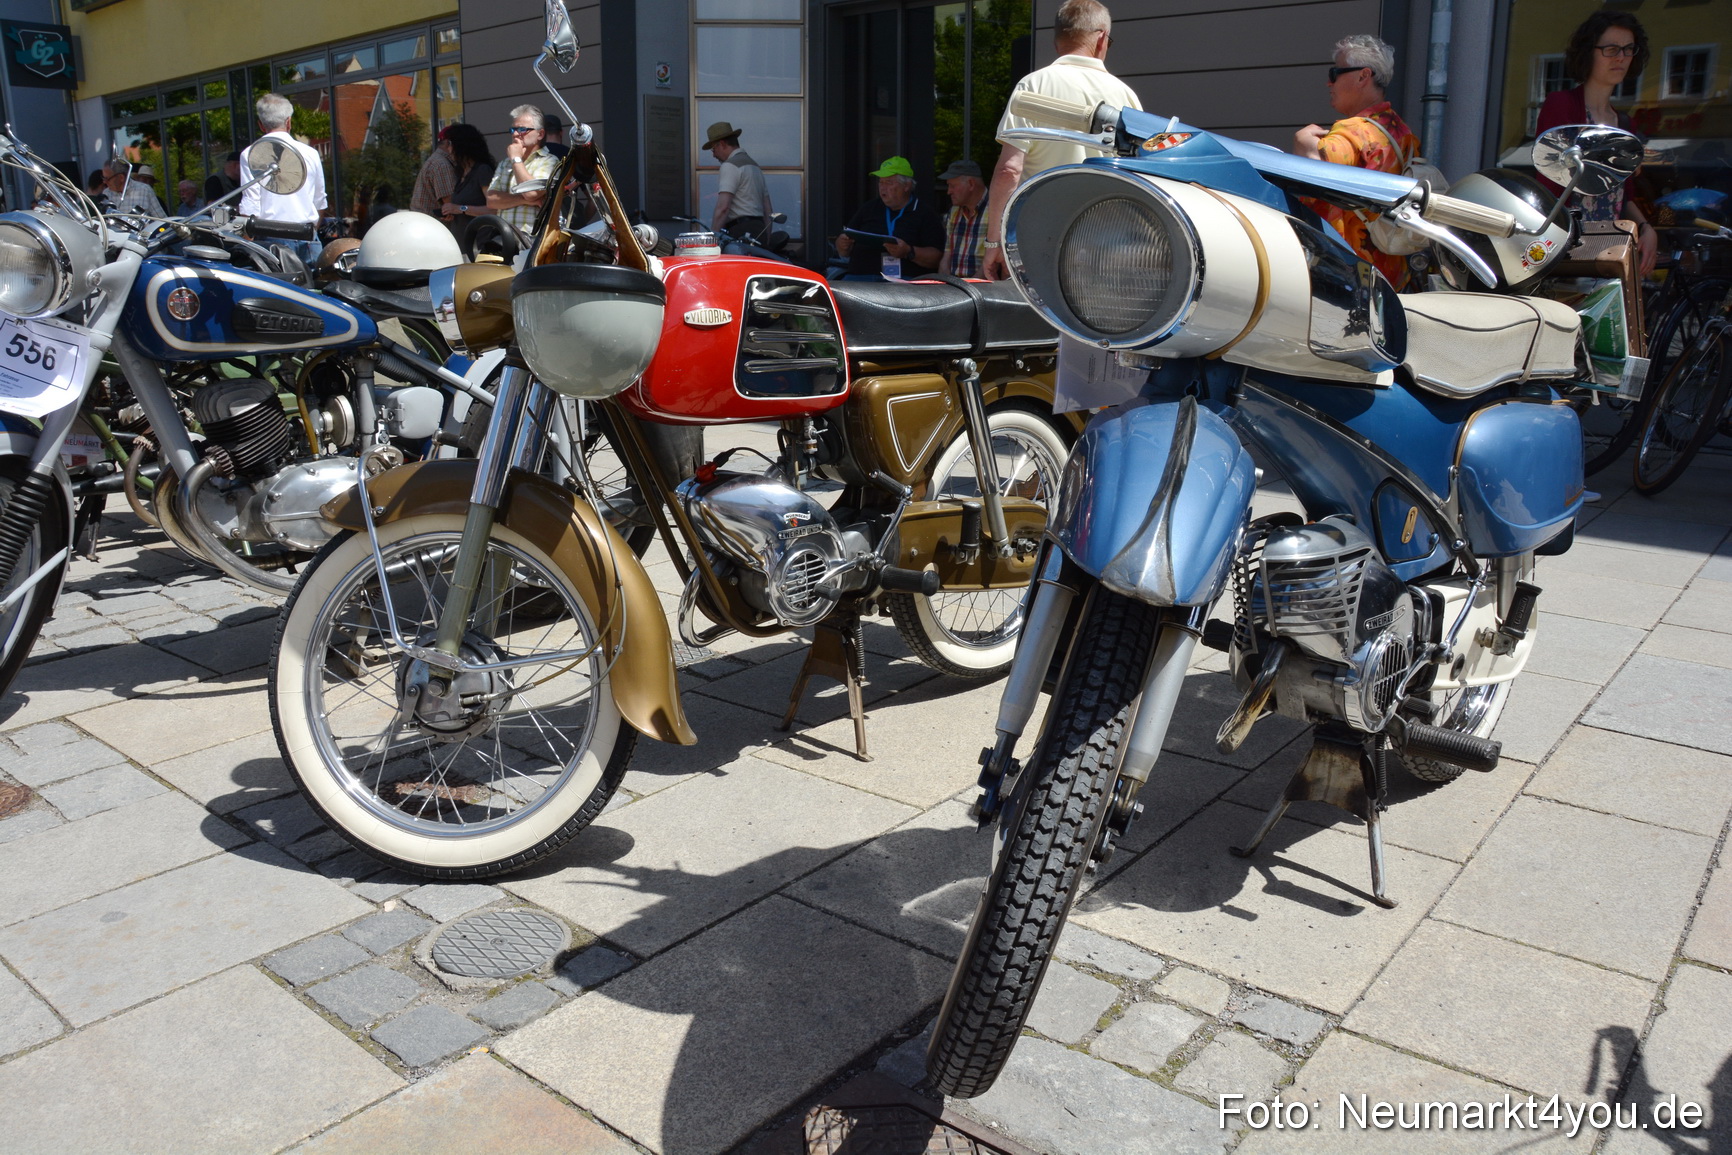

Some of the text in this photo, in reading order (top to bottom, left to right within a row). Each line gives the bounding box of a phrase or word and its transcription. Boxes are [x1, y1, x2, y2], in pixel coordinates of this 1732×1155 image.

[31, 40, 54, 65] G2
[691, 309, 728, 323] VICTORIA
[5, 333, 57, 371] 556
[64, 439, 99, 448] NEUMARKT
[780, 524, 821, 539] ZWEIRAD UNION
[1368, 612, 1394, 629] ZWEIRAD
